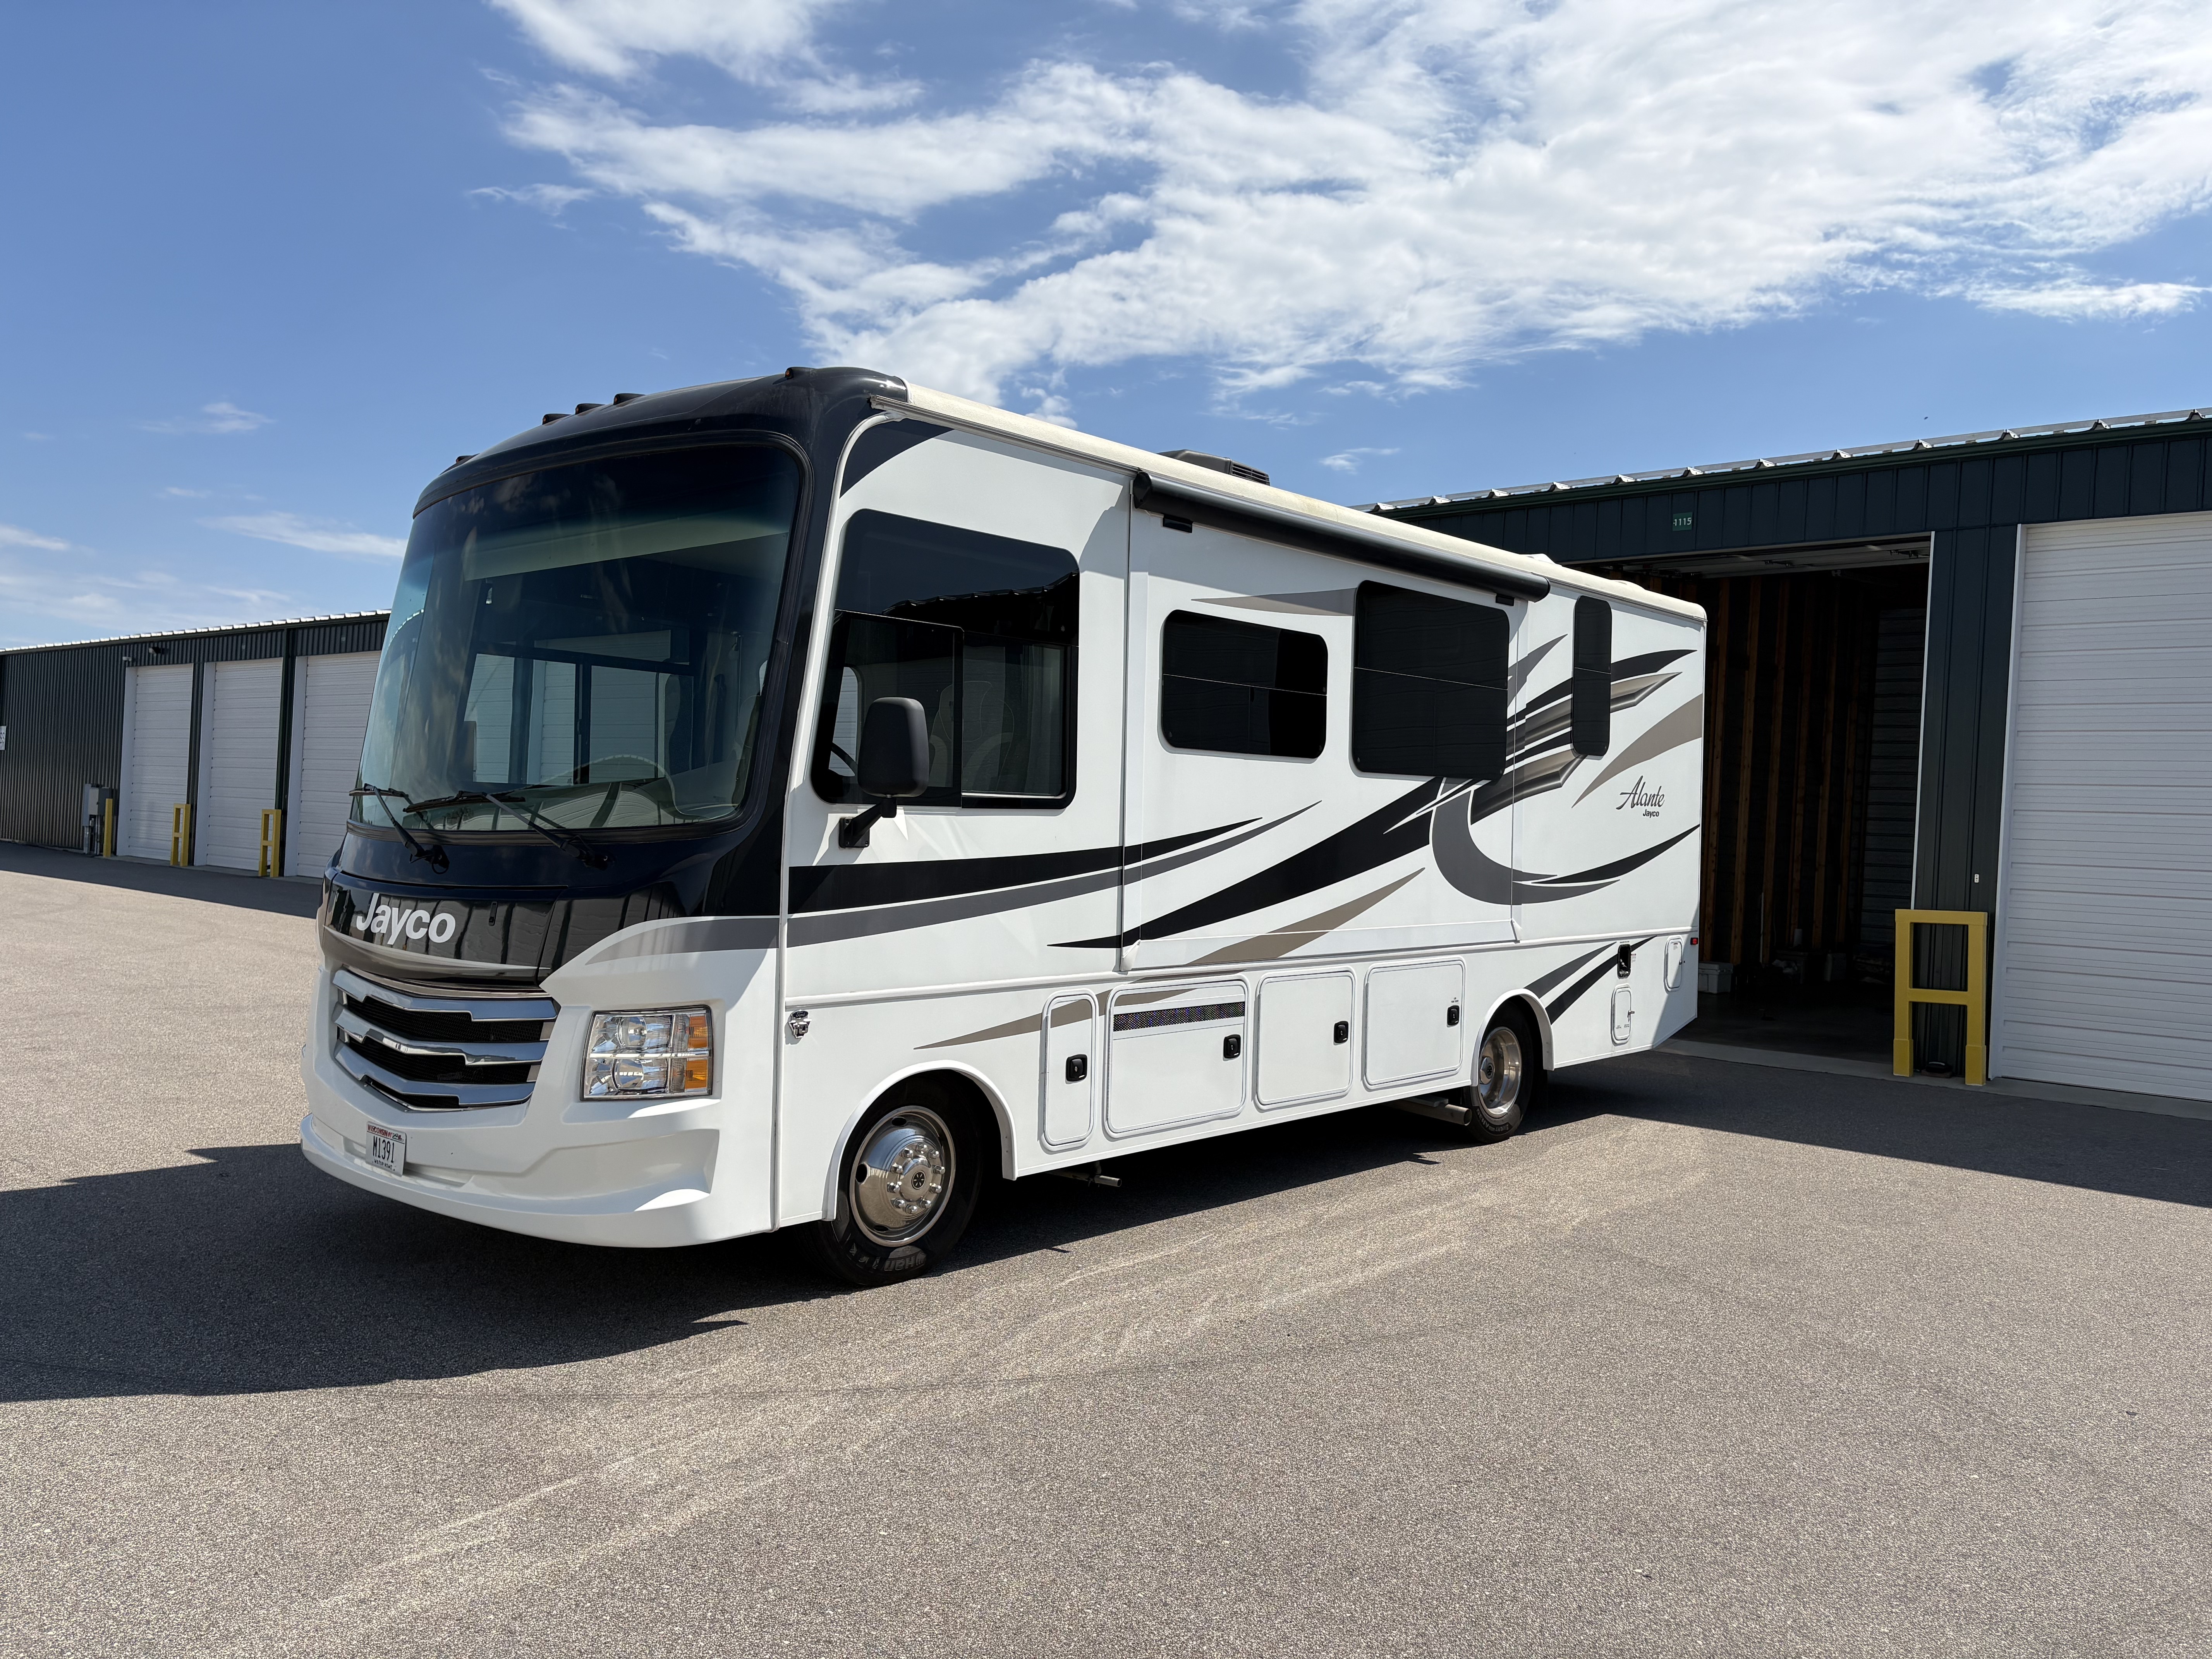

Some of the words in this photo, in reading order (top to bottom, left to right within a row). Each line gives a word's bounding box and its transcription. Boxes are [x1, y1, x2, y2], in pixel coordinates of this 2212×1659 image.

[1674, 517, 1692, 526] 1115
[1616, 775, 1665, 810] Alante
[1643, 809, 1659, 818] Jayco
[356, 893, 456, 945] Jayco
[368, 1124, 388, 1137] WISCONSIN
[373, 1135, 394, 1163] M1391
